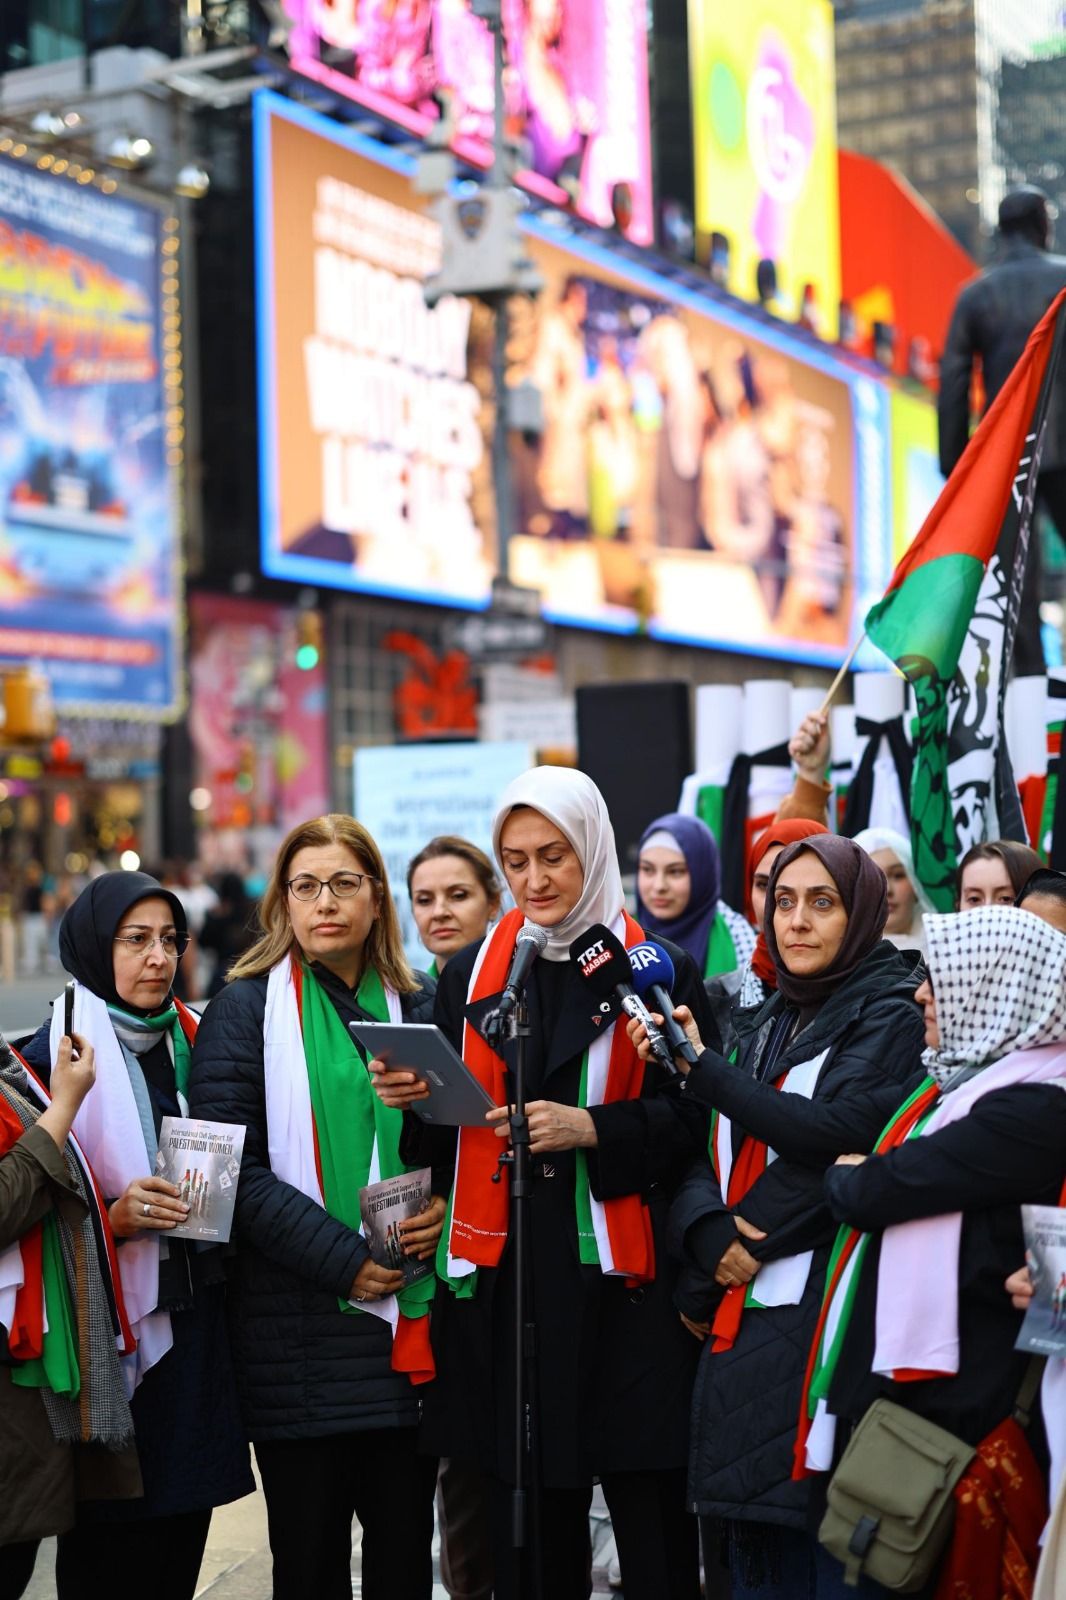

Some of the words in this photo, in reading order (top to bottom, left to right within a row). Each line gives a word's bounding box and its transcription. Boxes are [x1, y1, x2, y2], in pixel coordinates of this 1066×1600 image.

[577, 939, 605, 967] TRT
[583, 951, 611, 976] HABER
[629, 947, 661, 971] AA
[168, 1137, 207, 1152] PALESTINIAN
[209, 1142, 233, 1155] WOMEN
[171, 1128, 198, 1138] International
[208, 1132, 225, 1141] Support
[368, 1194, 400, 1214] PALESTINIAN
[402, 1187, 423, 1203] WOMEN
